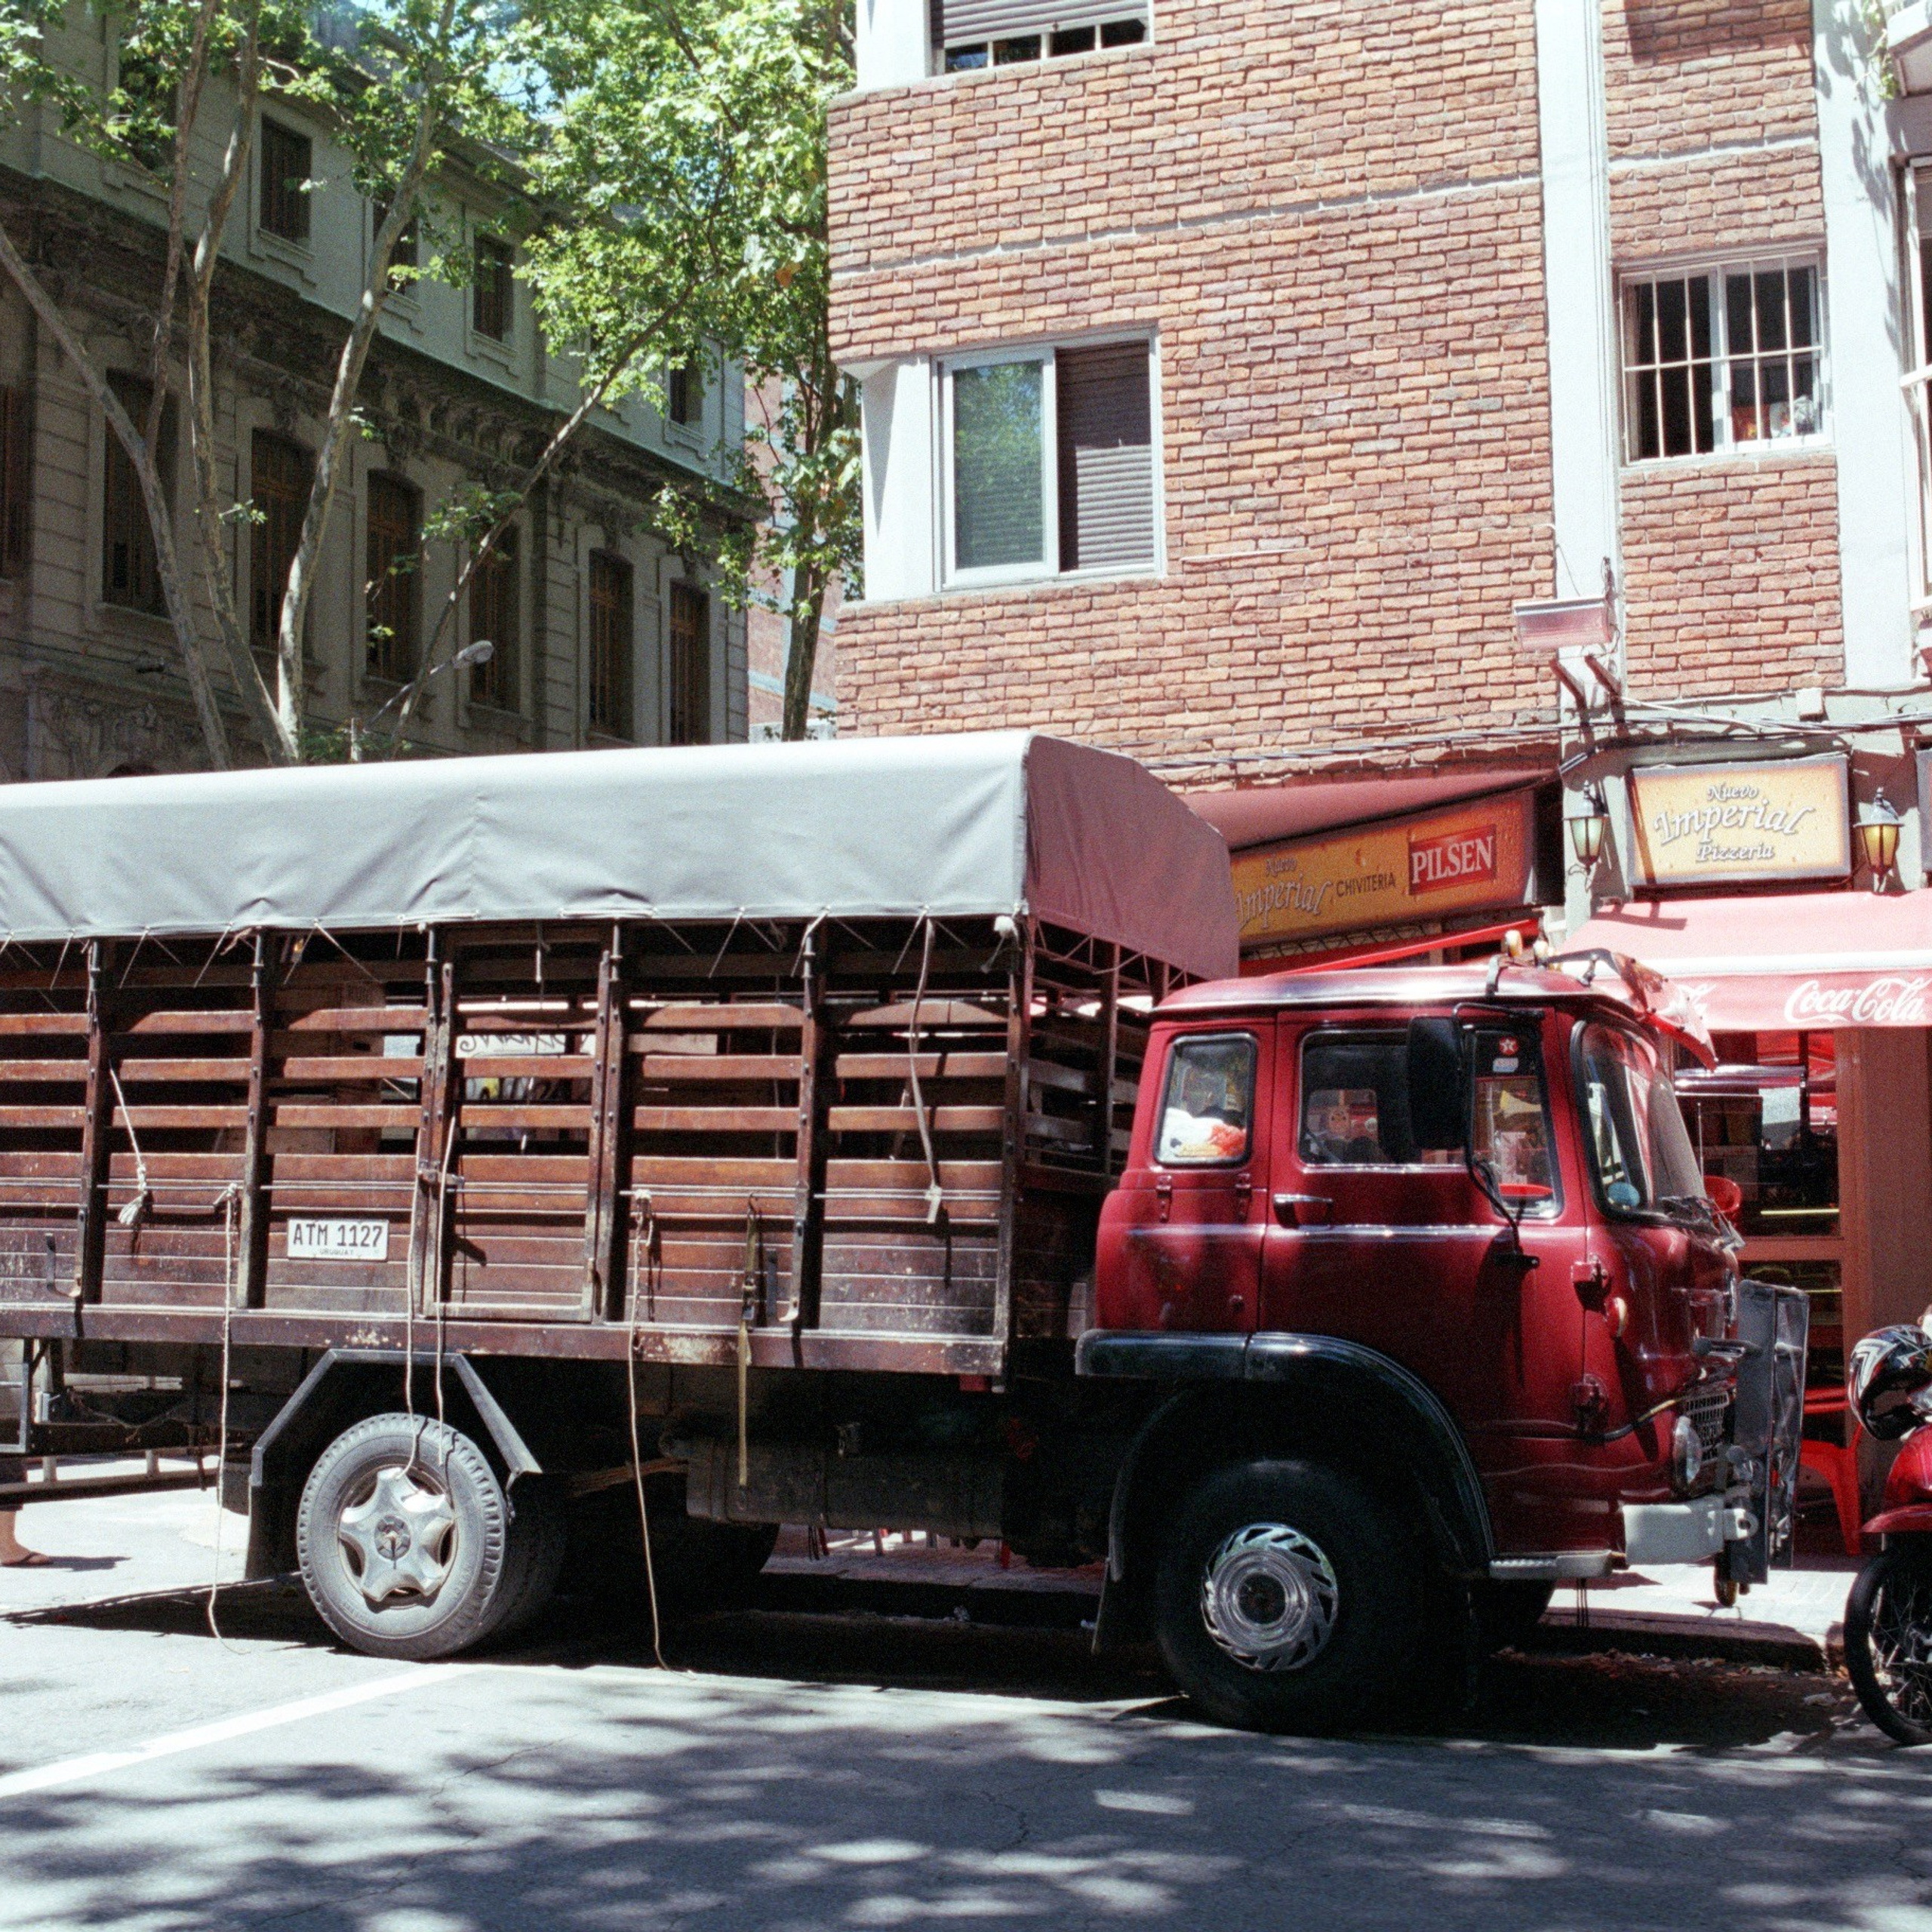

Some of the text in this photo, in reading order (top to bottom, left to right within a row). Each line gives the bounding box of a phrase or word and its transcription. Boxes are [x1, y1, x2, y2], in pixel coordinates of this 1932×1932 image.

[1706, 783, 1759, 801] Nuevo
[1654, 797, 1816, 848] Imperial
[1411, 835, 1495, 884] PILSEN
[1696, 841, 1775, 863] Pizzeria
[1235, 872, 1334, 930] Imperial
[1336, 872, 1396, 897] CHIVITERIA
[1783, 977, 1932, 1023] Coca-Cola
[293, 1223, 383, 1247] ATM 1127
